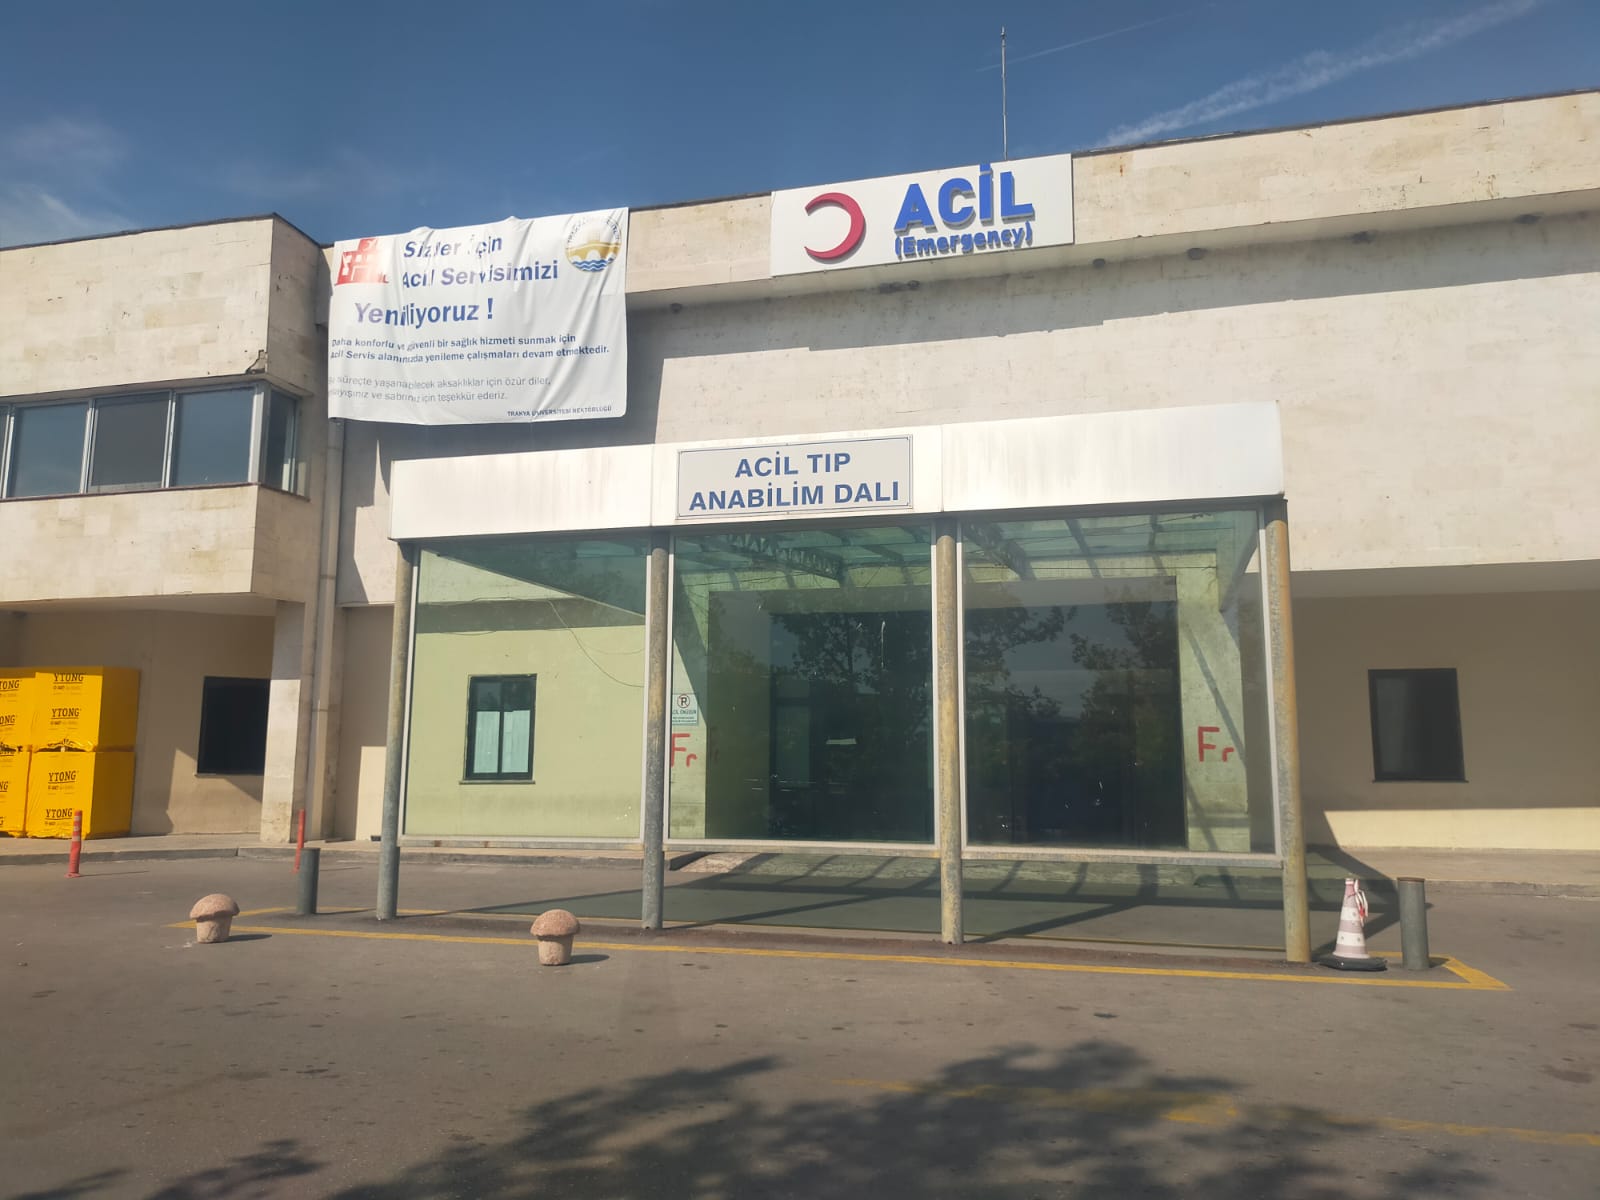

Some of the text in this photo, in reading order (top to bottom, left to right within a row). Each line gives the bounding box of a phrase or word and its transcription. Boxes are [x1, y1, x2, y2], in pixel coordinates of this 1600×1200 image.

[894, 163, 1034, 233] ACİL
[403, 239, 462, 258] Sizler
[895, 221, 1033, 259] (Emergency)
[440, 259, 558, 286] Servisimizi
[354, 297, 494, 329] Yeniliyoruz !
[437, 338, 449, 348] bir
[450, 336, 478, 349] sağlık
[480, 335, 516, 345] hizmeti
[518, 334, 557, 346] sunmak
[559, 333, 576, 345] için
[345, 350, 376, 360] Servis
[424, 351, 465, 364] yenileme
[467, 349, 520, 362] çalışmaları
[522, 350, 554, 359] devam
[556, 344, 610, 358] etmektedir.
[486, 376, 503, 388] için
[505, 376, 527, 386] özür
[735, 451, 851, 478] ACİL TIP
[689, 481, 899, 511] ANABİLİM DALI
[53, 672, 84, 682] YTONG
[51, 708, 80, 718] YTONG
[1198, 726, 1235, 762] Fr
[48, 770, 77, 782] YTONG
[46, 808, 73, 818] YTONG
